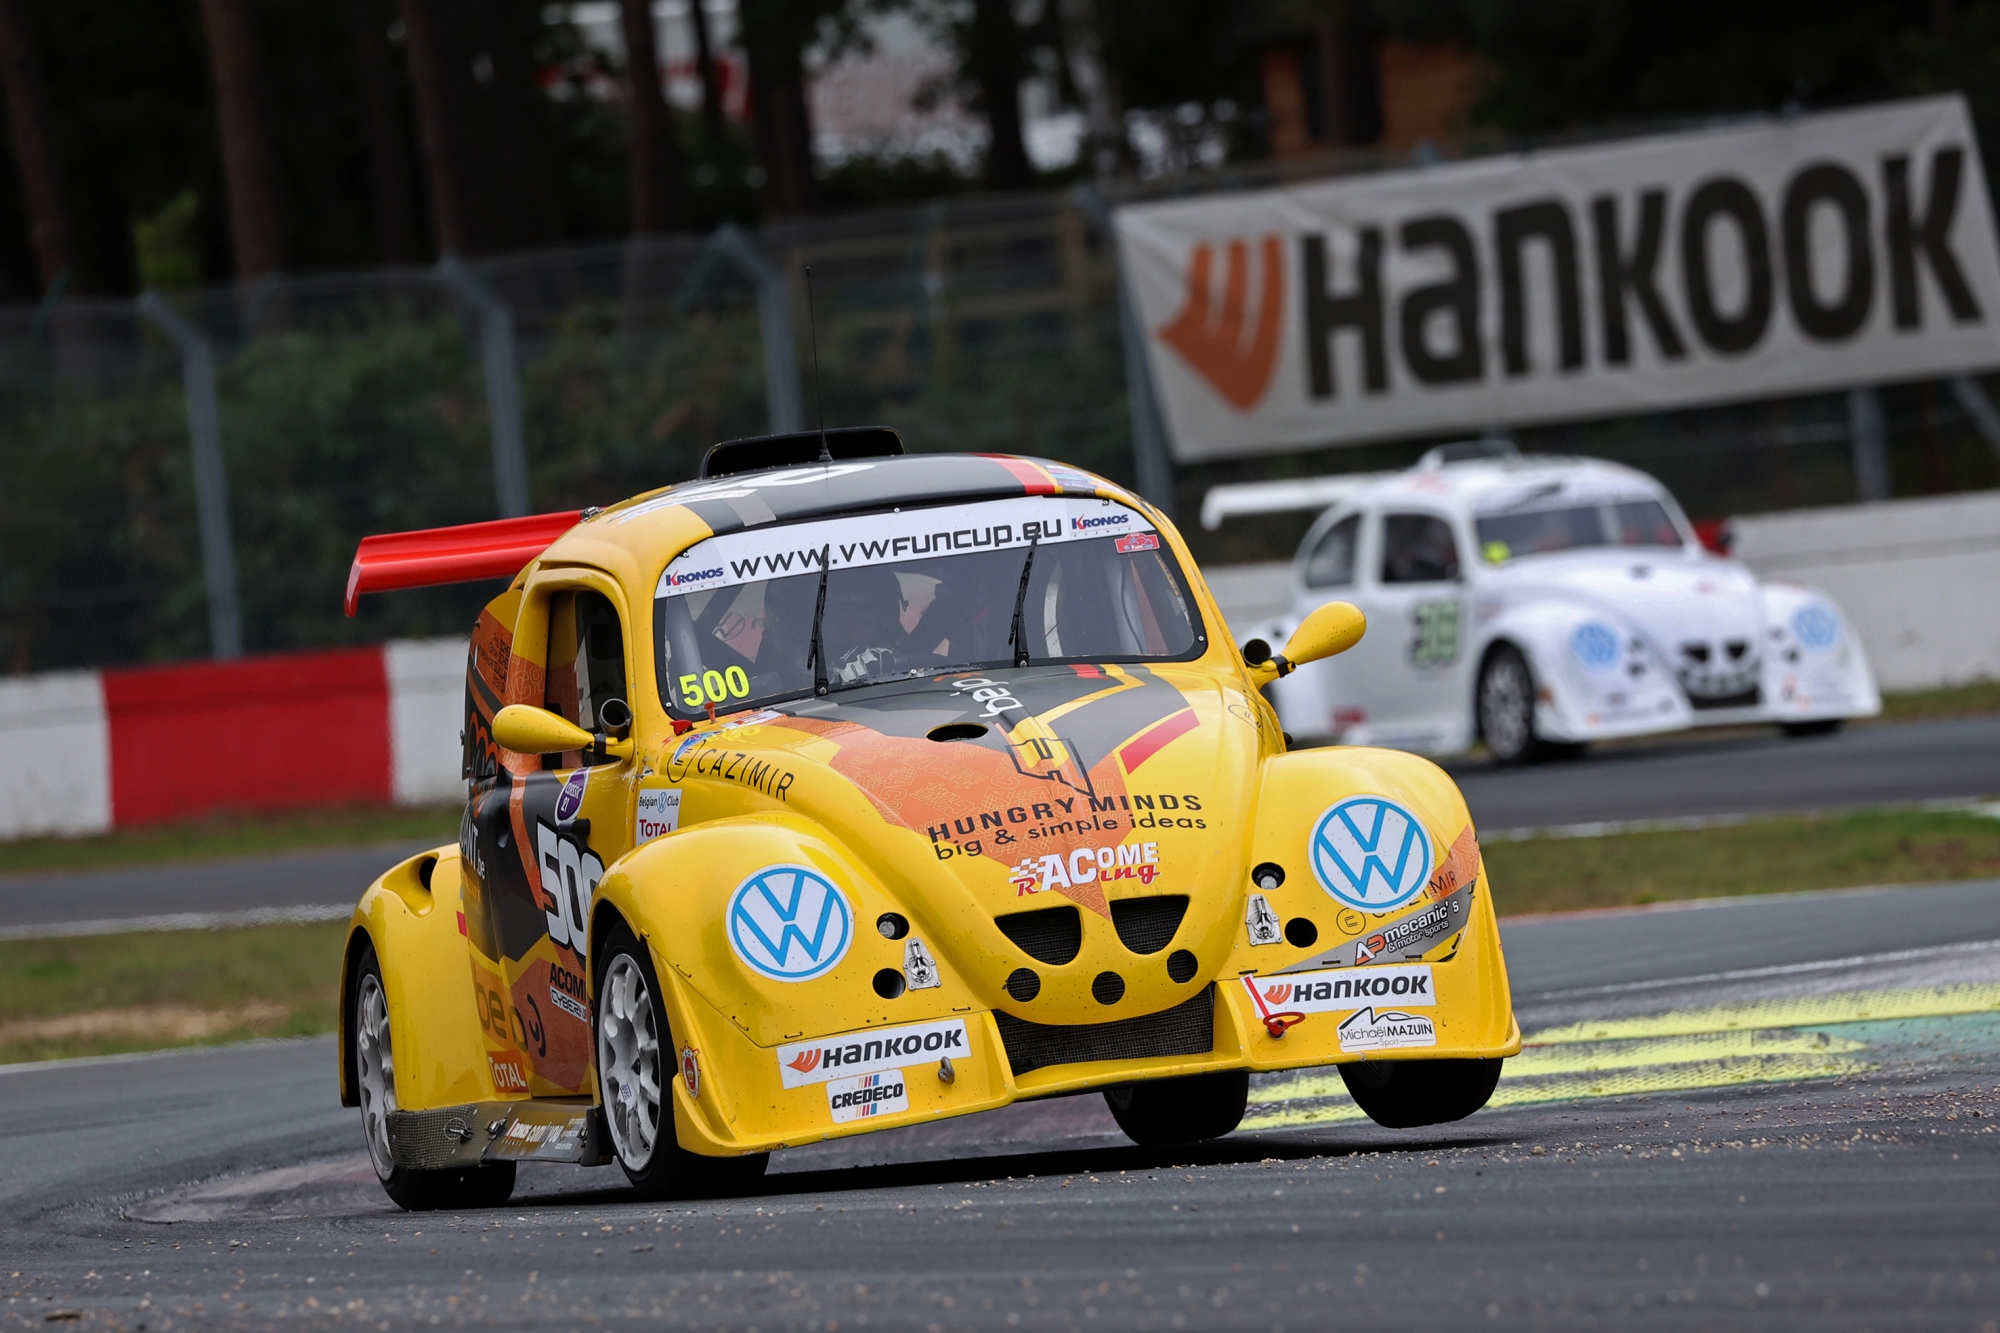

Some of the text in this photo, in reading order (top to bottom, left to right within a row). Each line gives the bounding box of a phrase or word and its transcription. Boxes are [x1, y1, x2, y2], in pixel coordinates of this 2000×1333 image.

[1302, 143, 1984, 403] HANKOOK
[1071, 513, 1129, 530] KRONOS
[666, 567, 725, 587] KRONOS
[679, 665, 750, 706] 500
[697, 747, 795, 801] CAZIMIR
[638, 796, 658, 810] Belgian
[667, 795, 680, 806] Club
[927, 794, 1202, 843] HUNGRY MINDS
[934, 812, 1207, 860] big & simple ideas
[1398, 931, 1422, 949] motor
[1425, 920, 1449, 937] sports
[1293, 975, 1428, 1003] HANKOOK
[822, 1028, 963, 1069] HANKOOK
[1379, 1038, 1399, 1047] Sport
[488, 1055, 527, 1089] TOTAL
[831, 1082, 903, 1110] CREDECO
